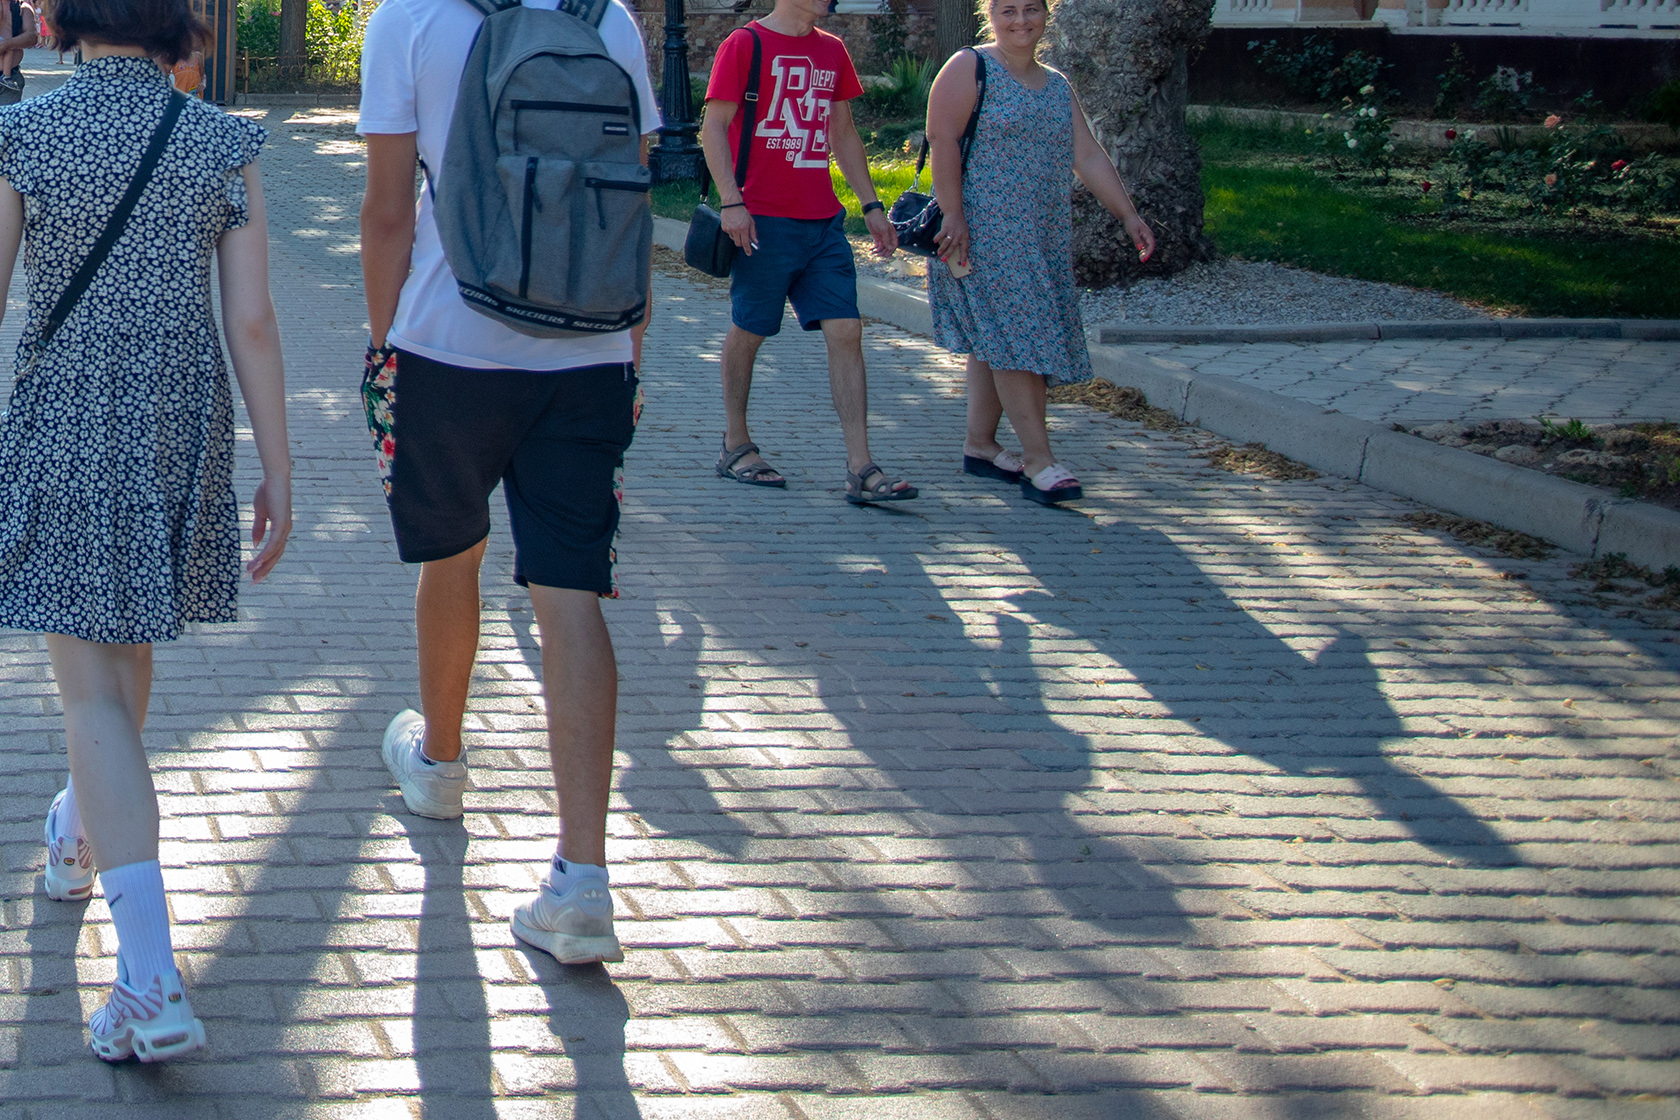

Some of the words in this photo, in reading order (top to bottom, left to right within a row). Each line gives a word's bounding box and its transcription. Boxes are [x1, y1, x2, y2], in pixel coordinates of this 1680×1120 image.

[812, 69, 836, 88] DEPT.
[459, 286, 498, 307] ECHERS
[505, 305, 566, 324] SKECHERS
